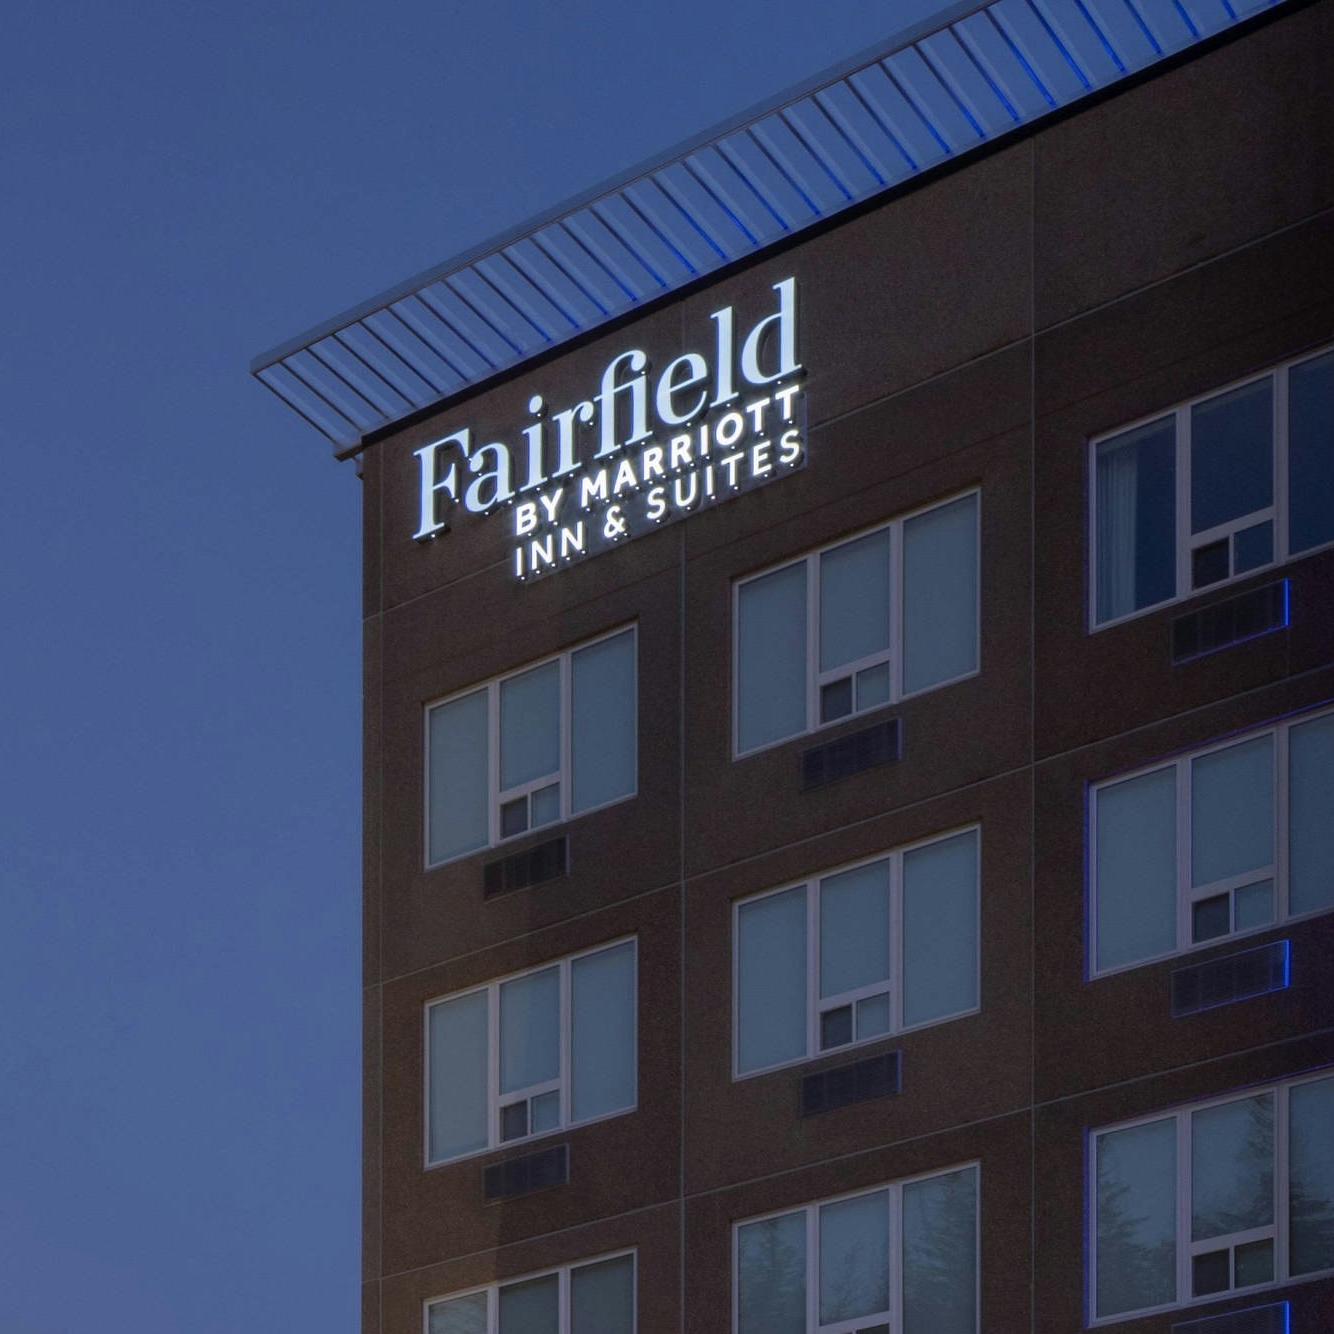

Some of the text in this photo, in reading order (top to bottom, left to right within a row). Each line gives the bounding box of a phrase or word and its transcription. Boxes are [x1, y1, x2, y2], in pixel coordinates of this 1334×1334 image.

[413, 277, 802, 540] Fairfield
[515, 385, 800, 537] BY MARRIOTT
[515, 428, 801, 577] INN & SUITES
